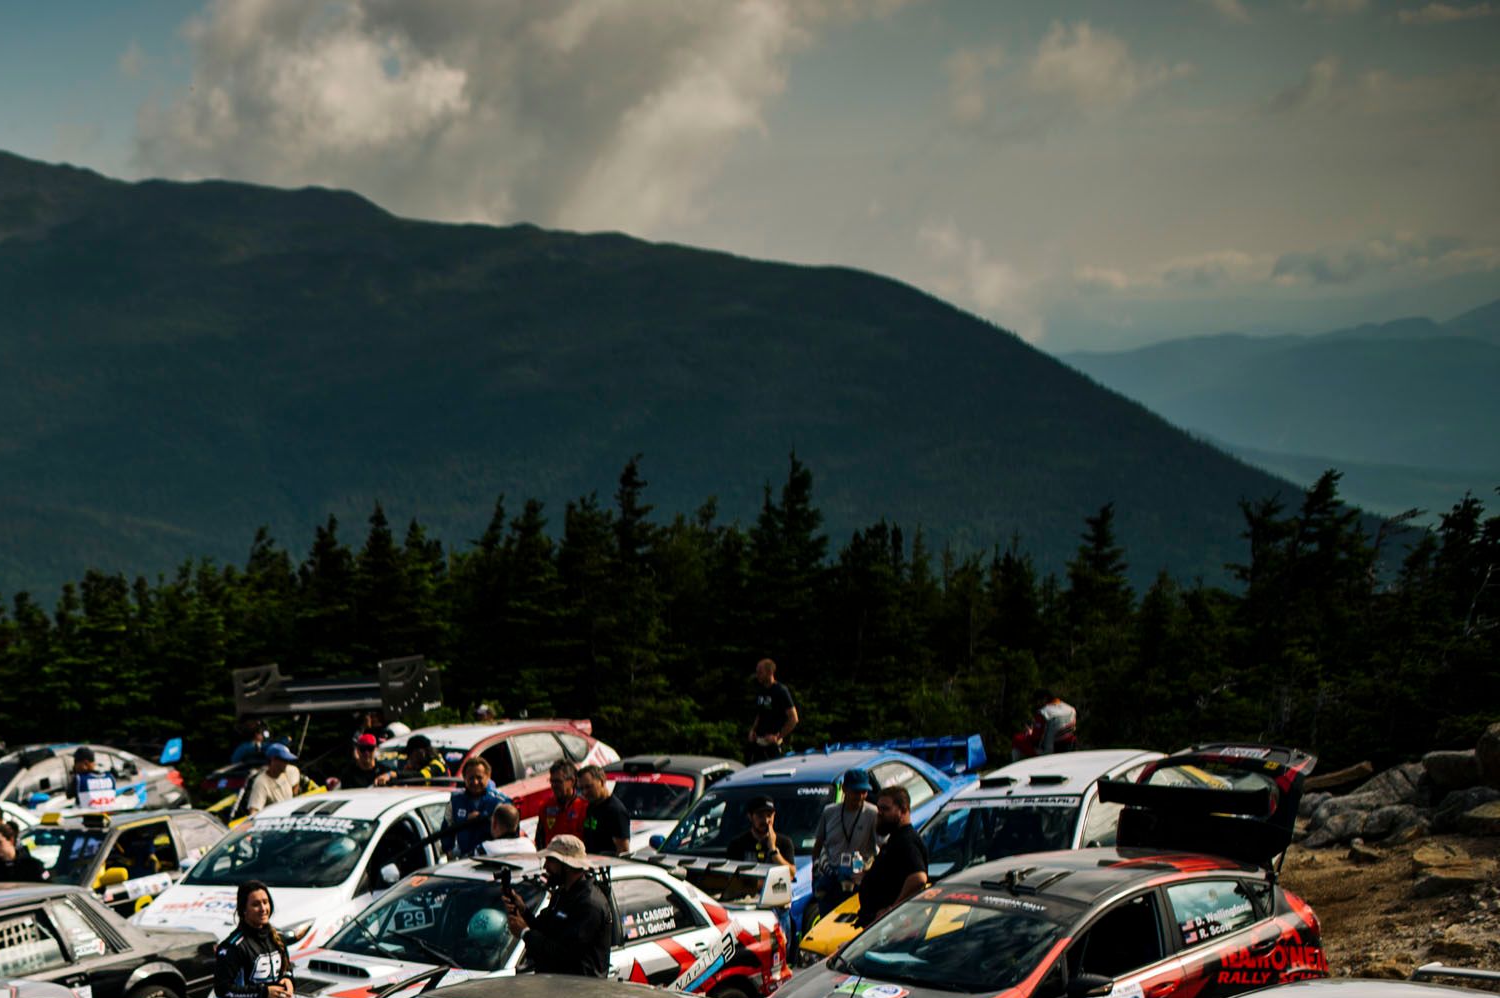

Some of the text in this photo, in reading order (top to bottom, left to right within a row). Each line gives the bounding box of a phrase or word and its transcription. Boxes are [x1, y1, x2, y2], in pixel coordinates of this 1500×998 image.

[403, 910, 426, 928] 29
[636, 906, 675, 924] J. CASSIDY
[1195, 916, 1206, 928] D.
[639, 918, 676, 937] D. Getchell
[1199, 928, 1209, 940] R.
[1217, 971, 1271, 985] RALLY
